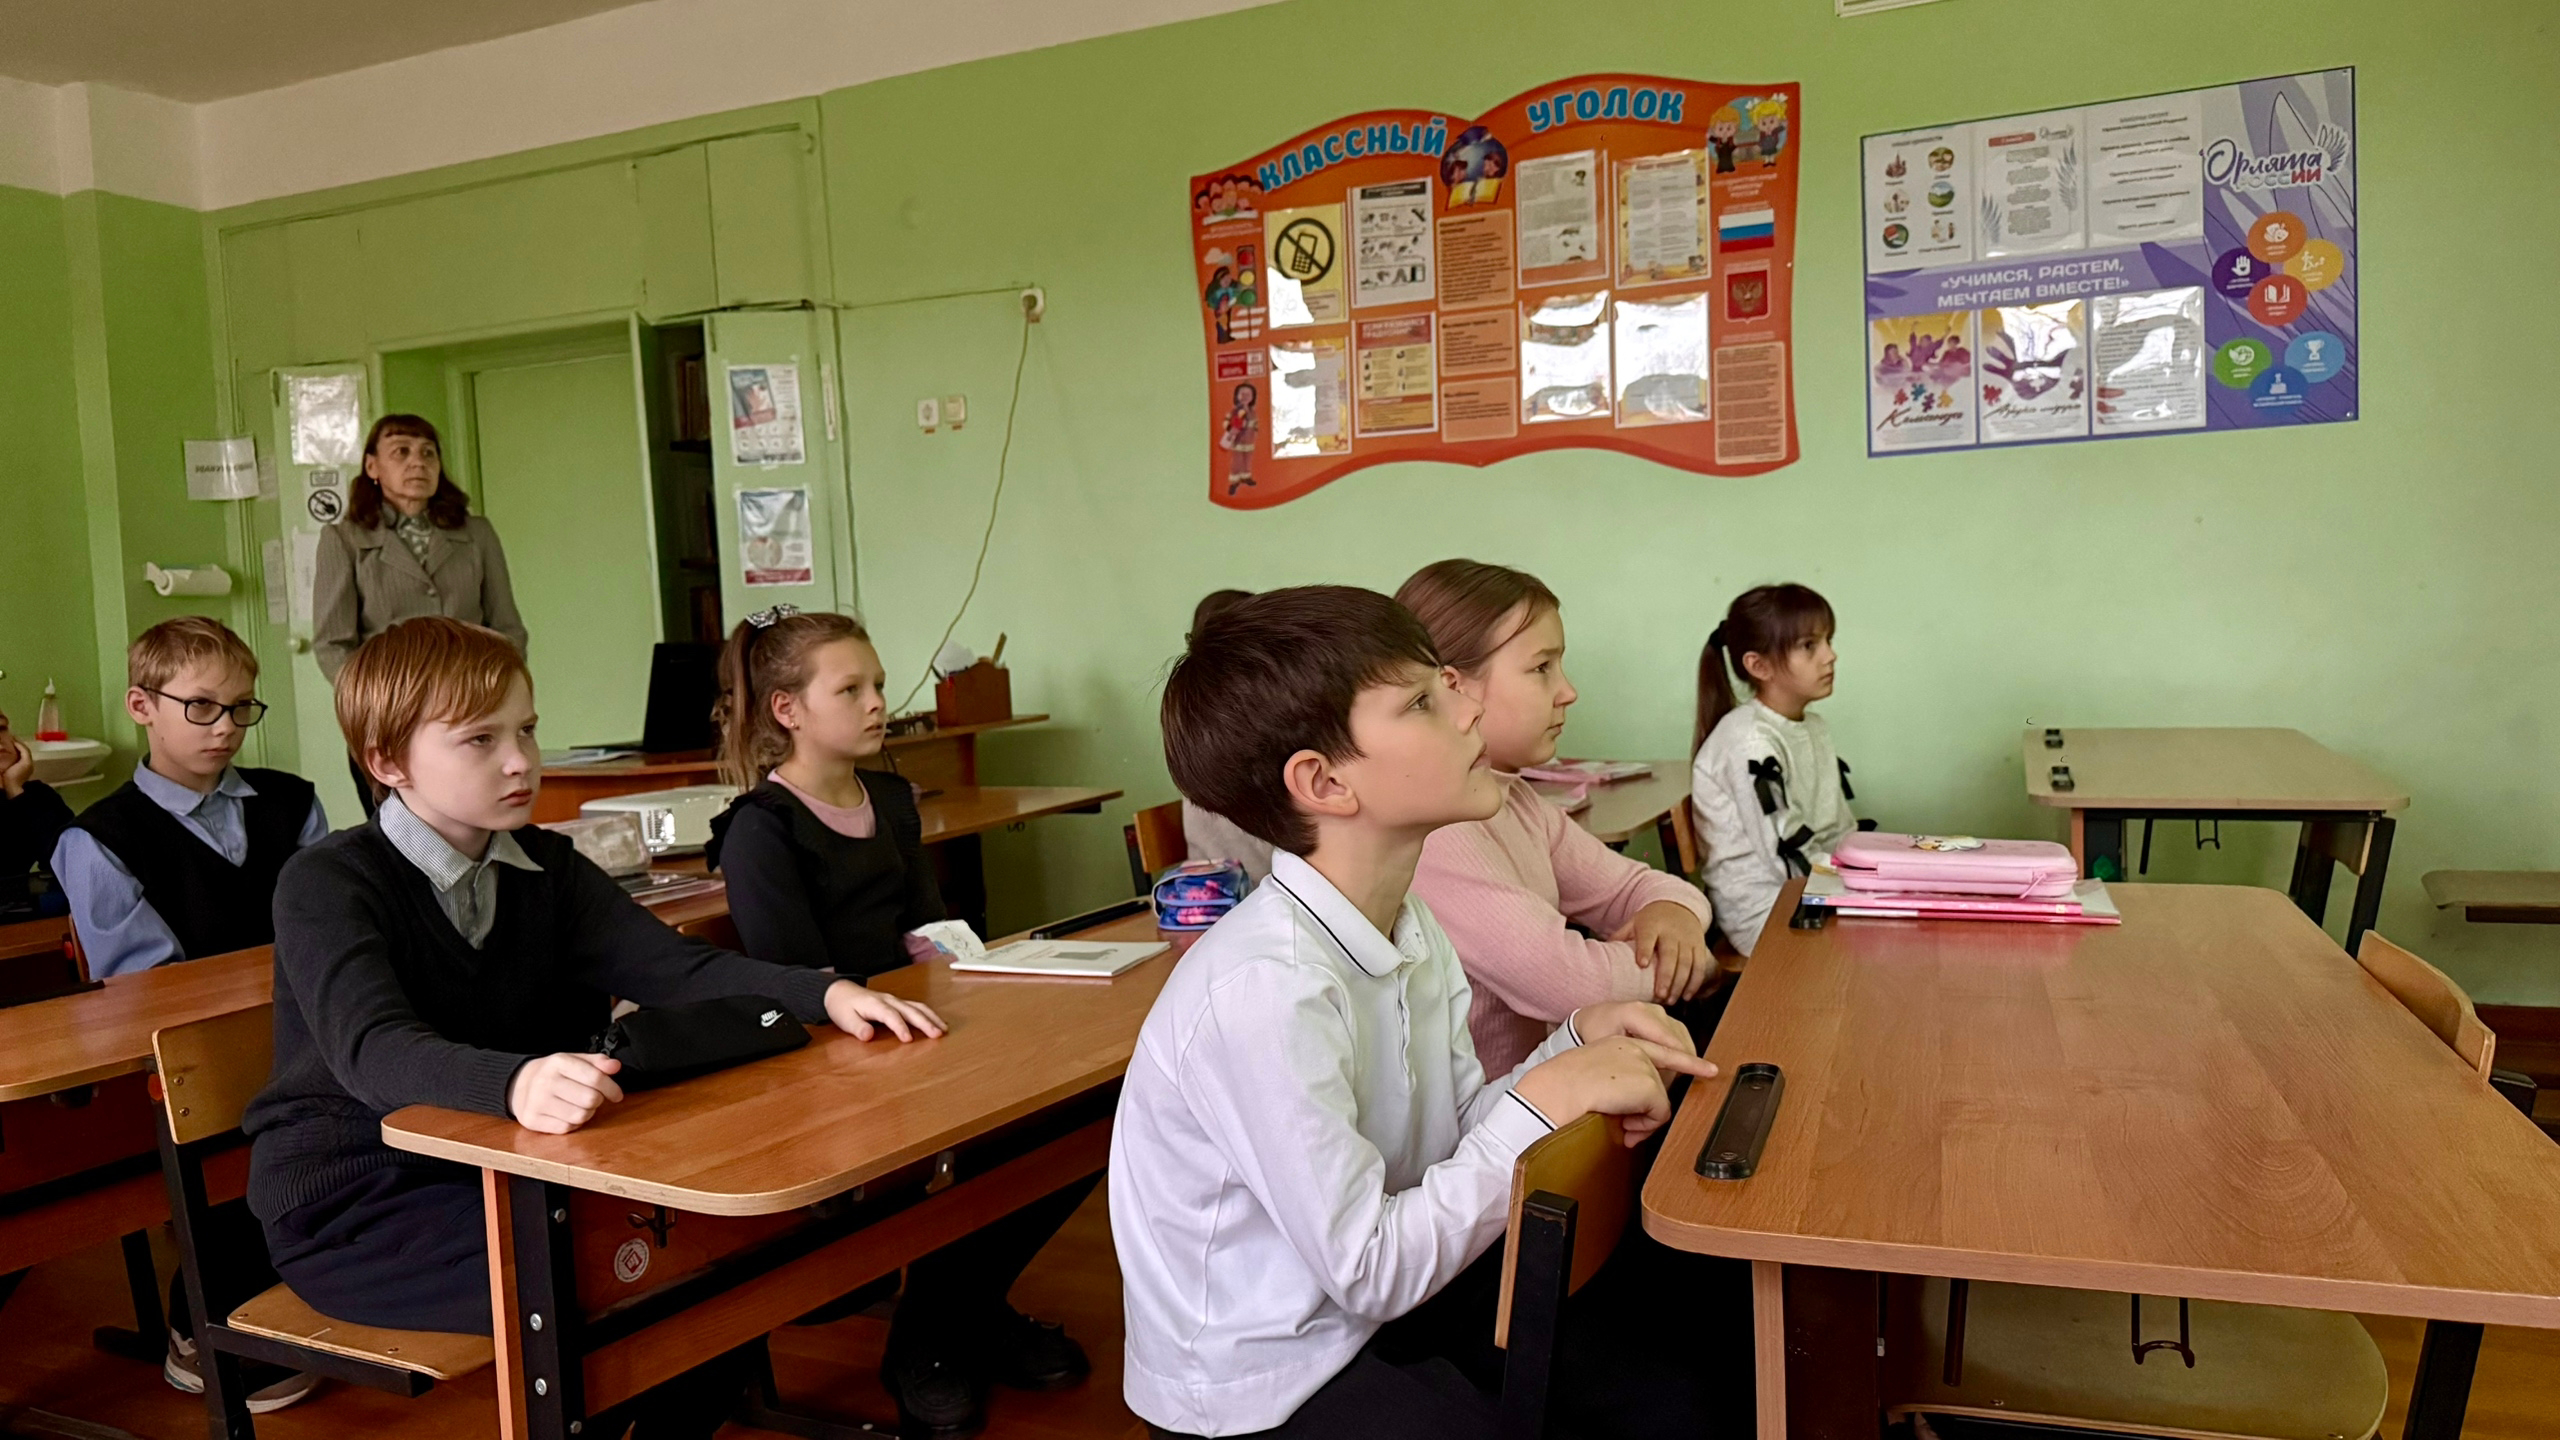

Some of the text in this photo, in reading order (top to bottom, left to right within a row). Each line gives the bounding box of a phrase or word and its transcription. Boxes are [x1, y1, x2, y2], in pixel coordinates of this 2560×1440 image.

[1257, 87, 1684, 192] КЛАССНЫЙ УГОЛОК
[2207, 138, 2322, 184] Орлята
[1937, 276, 2130, 308] МЕЧТАЕМ ВМЕСТЕ!»
[1941, 258, 2124, 289] «УЧИМСЯ, РАСТЕМ,
